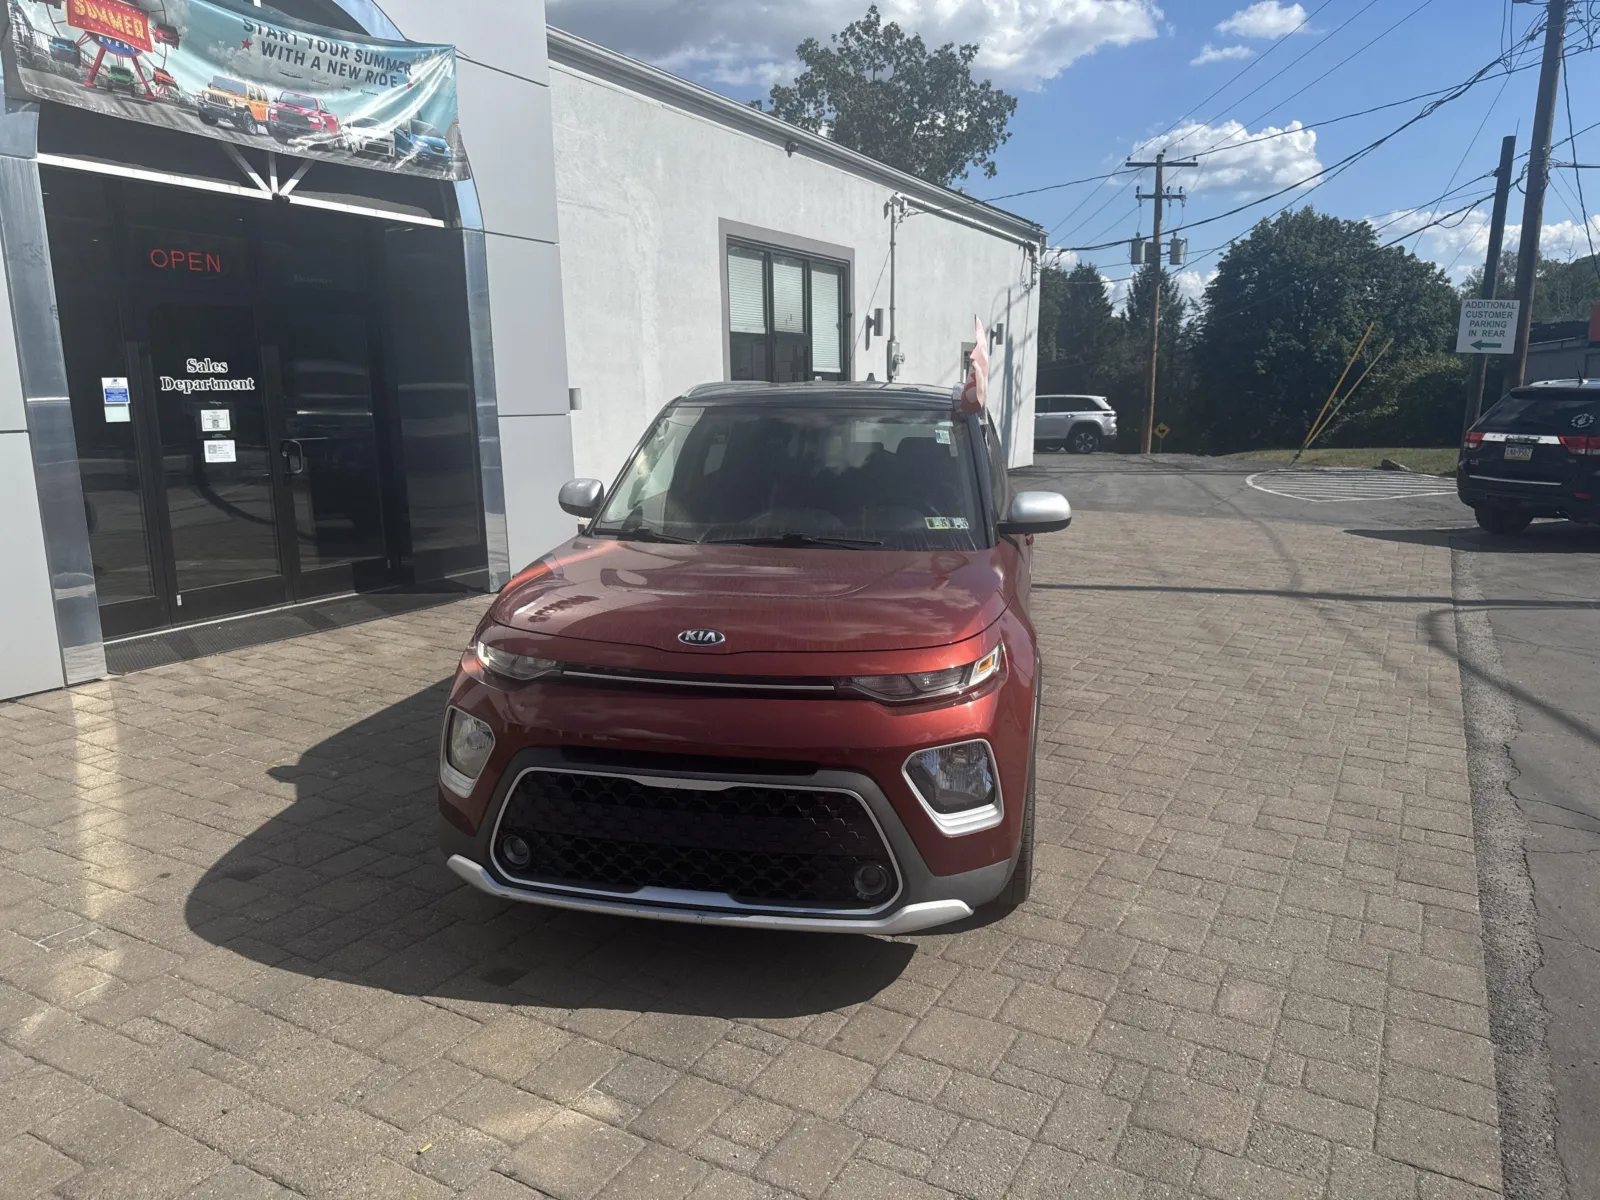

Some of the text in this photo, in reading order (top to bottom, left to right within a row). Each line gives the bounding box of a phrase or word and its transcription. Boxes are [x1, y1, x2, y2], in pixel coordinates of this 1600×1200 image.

[73, 0, 146, 40] SUMMER
[98, 36, 136, 52] EVENT
[243, 18, 412, 76] START YOUR SUMMER
[261, 40, 398, 88] WITH A NEW RIDE
[150, 249, 221, 273] OPEN
[1465, 301, 1517, 310] ADDITIONAL
[1465, 310, 1513, 319] CUSTOMER
[1469, 320, 1508, 329] PARKING
[1481, 330, 1506, 338] REAR
[186, 358, 229, 373] Sales
[160, 376, 256, 395] Department
[685, 630, 717, 642] KIA
